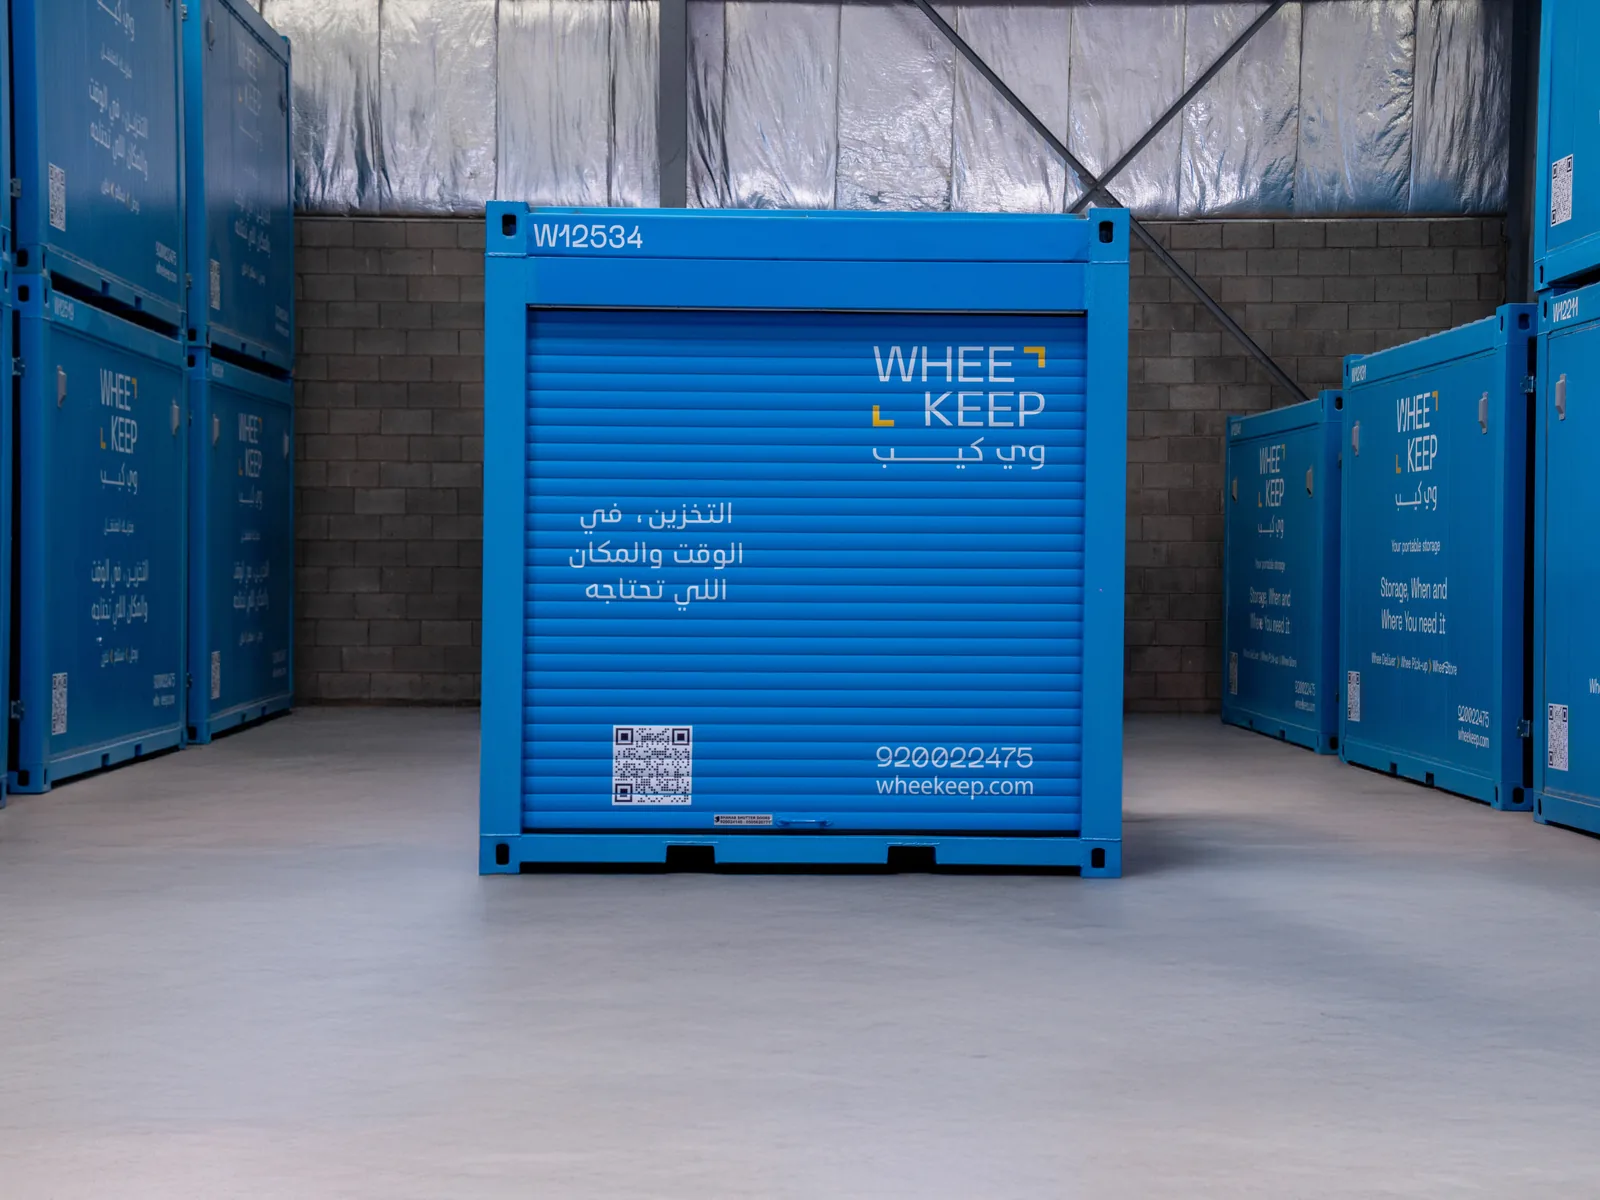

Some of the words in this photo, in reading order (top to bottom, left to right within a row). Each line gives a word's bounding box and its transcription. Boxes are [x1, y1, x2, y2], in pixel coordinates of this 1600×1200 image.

[533, 223, 643, 249] W12534
[873, 345, 1015, 383] WHEE
[100, 368, 131, 411] WHEE
[924, 391, 1046, 428] KEEP
[1396, 392, 1431, 433] WHEE
[111, 415, 138, 454] KEEP
[872, 436, 985, 470] كيب
[995, 444, 1046, 470] وي
[1407, 434, 1438, 473] KEEP
[1424, 485, 1438, 512] وي
[580, 502, 622, 535] في
[569, 539, 663, 569] والمكان
[673, 542, 743, 570] الوقت
[585, 578, 665, 604] تحتاجه
[673, 578, 727, 612] اللي
[1380, 576, 1409, 603] Storage,
[1411, 577, 1431, 599] When
[1432, 577, 1448, 600] and
[1381, 609, 1402, 631] Where
[1404, 610, 1418, 632] You
[1419, 612, 1437, 634] need
[1439, 612, 1446, 634] it
[1458, 704, 1490, 728] 920022475
[876, 745, 1034, 769] 920022475
[876, 774, 1034, 801] wheekeep.com
